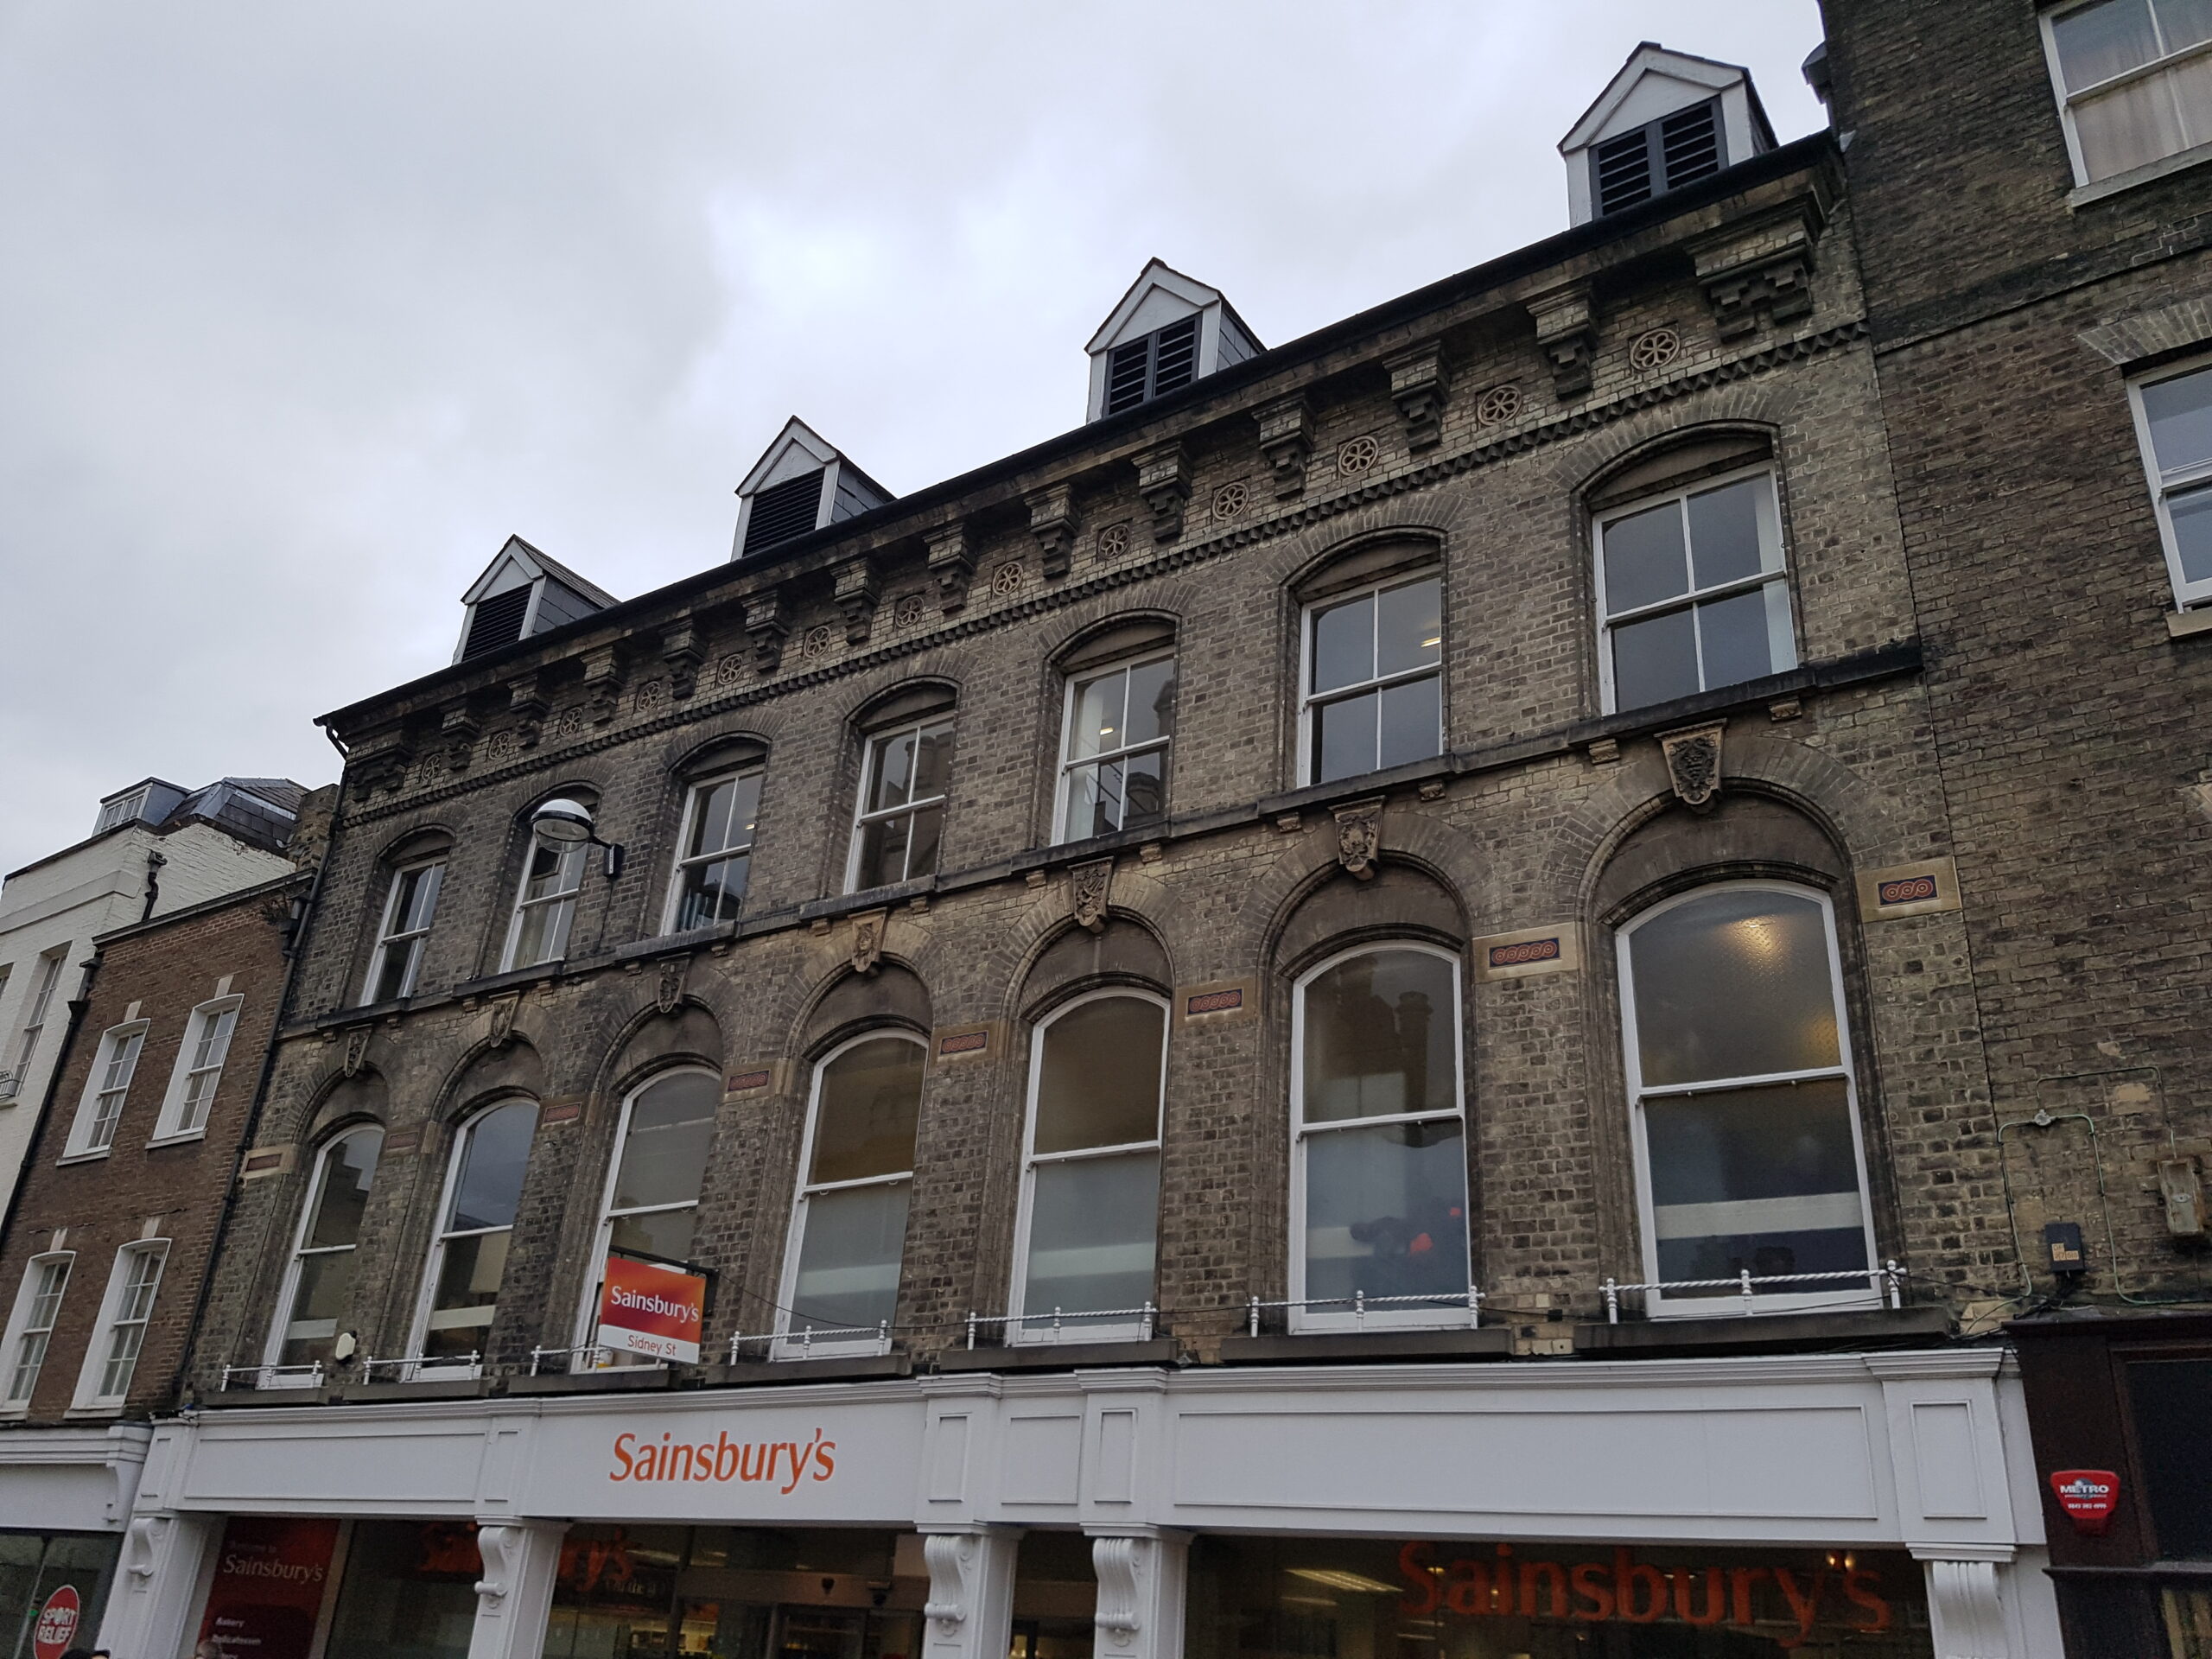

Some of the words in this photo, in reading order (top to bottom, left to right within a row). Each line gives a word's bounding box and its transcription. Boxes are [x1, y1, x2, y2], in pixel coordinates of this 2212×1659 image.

[611, 1285, 699, 1323] Sainsbury's
[627, 1335, 662, 1355] Sidney
[665, 1343, 677, 1356] St
[609, 1427, 836, 1495] Sainsbury's
[2060, 1484, 2109, 1494] METRO
[223, 1554, 324, 1585] Sainsbury's
[1397, 1540, 1891, 1648] Sainsbury's
[41, 1607, 76, 1625] SPORT
[38, 1625, 72, 1644] RELIEF
